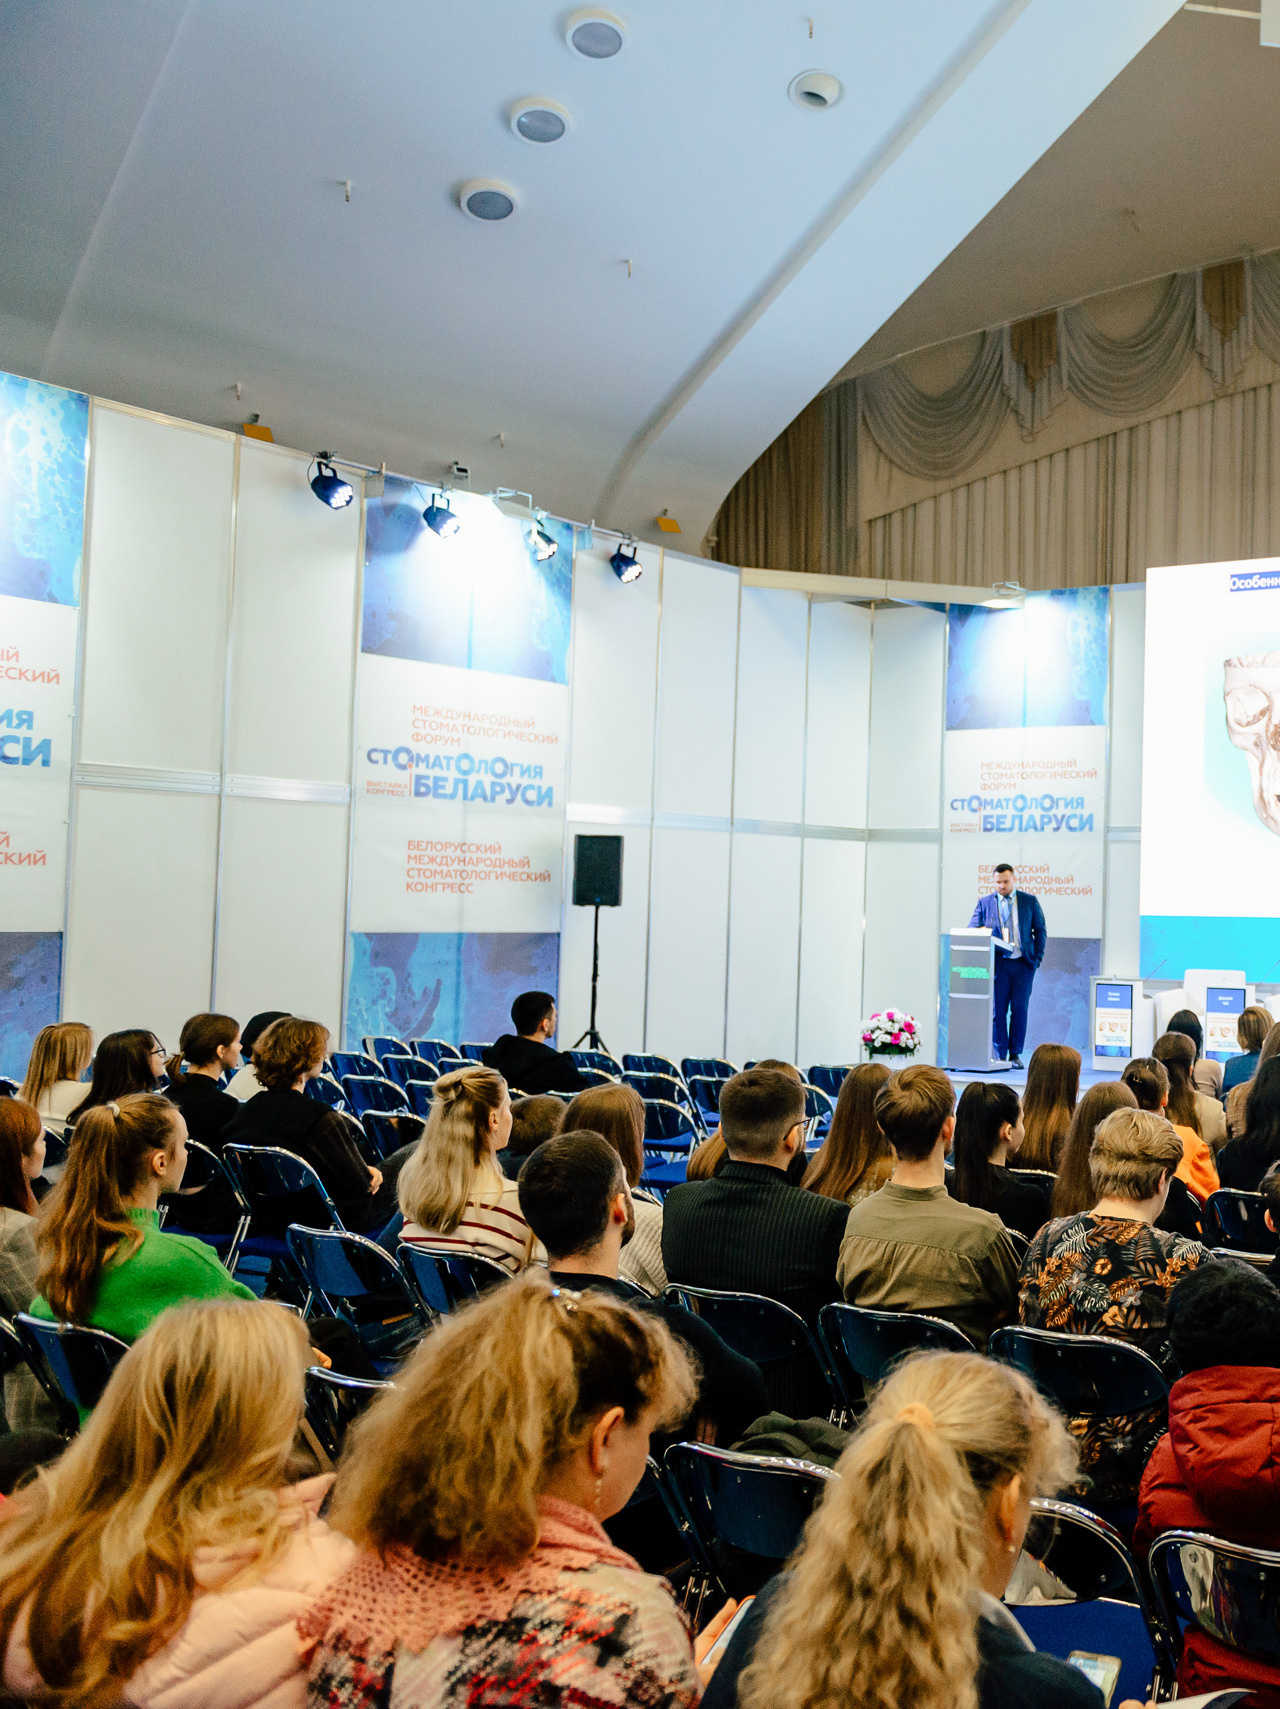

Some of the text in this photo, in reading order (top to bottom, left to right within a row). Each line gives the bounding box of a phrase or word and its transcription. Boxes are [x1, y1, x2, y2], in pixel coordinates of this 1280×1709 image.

[412, 704, 536, 730] МЕЖДУНАРОДНЫЙ
[412, 718, 559, 745] СТОМАТОЛОГИЧЕСКИЙ
[411, 732, 461, 747] ФОРУМ
[366, 746, 543, 780] СТОМАТОЛОГИЯ
[980, 758, 1077, 770] МЕЖДУНАРОДНЫЙ
[980, 768, 1098, 781] СТОМАТОЛОГИЧЕСКИЙ
[414, 774, 554, 808] БЕЛАРУСИ
[980, 782, 1017, 791] ФОРУМ
[950, 793, 1085, 813] СТОМАТОЛОГИЯ
[982, 813, 1094, 833] БЕЛАРУСИ
[407, 840, 502, 855] БЕЛОРУССКИЙ
[407, 854, 530, 870] МЕЖДУНАРОДНЫЙ
[406, 868, 551, 883] СТОМАТОЛОГИЧЕСКИЙ
[406, 882, 474, 894] КОНГРЕСС
